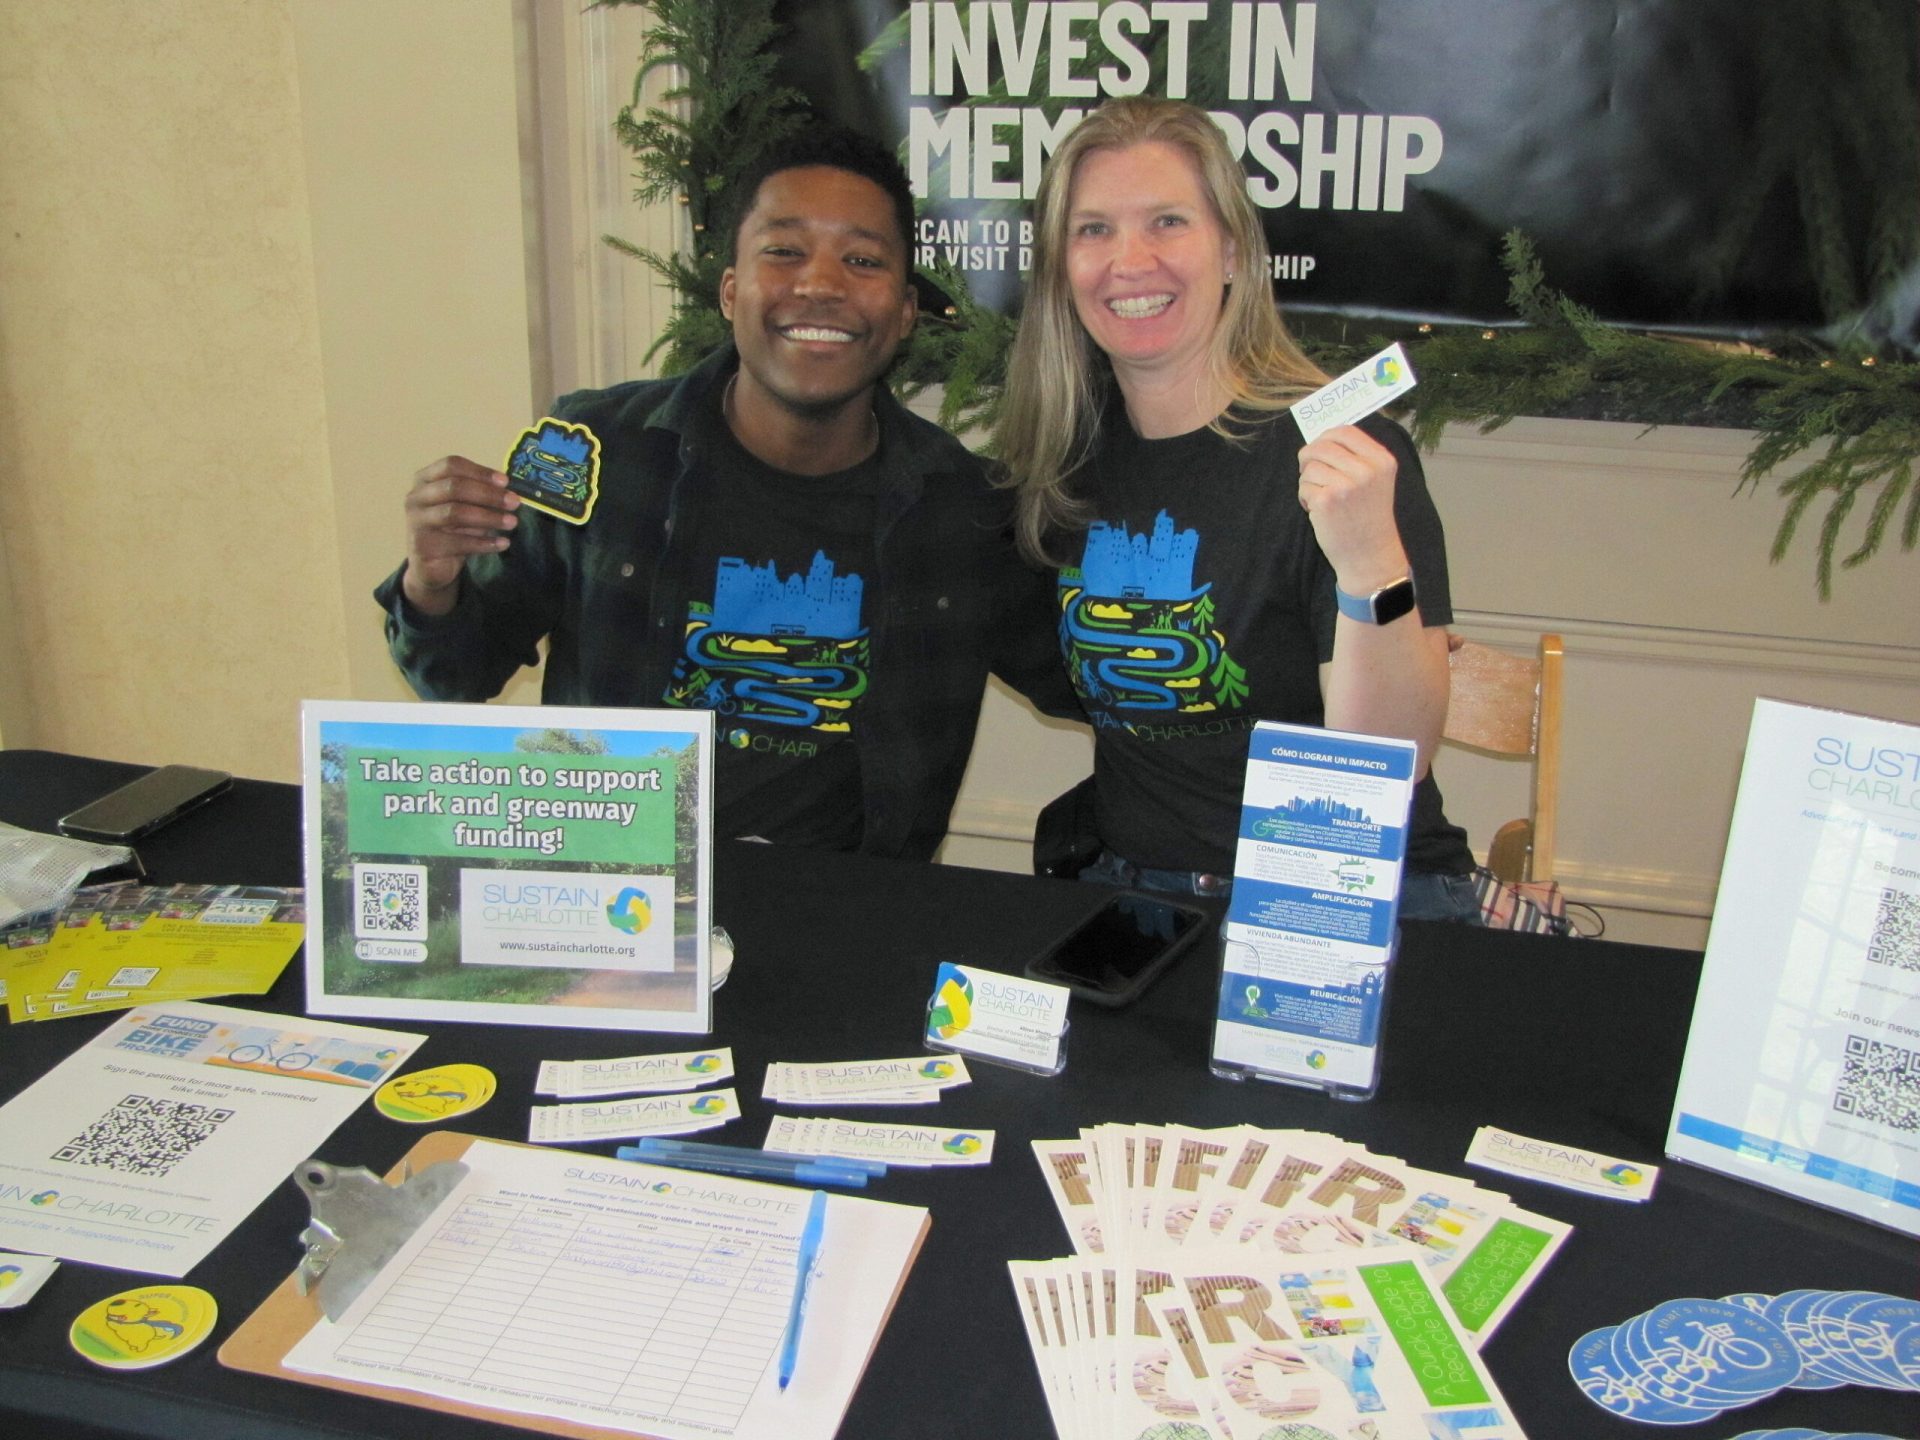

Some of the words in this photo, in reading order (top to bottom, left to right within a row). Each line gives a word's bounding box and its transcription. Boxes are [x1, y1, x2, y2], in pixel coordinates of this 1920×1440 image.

[910, 1, 1207, 99] INVEST
[1229, 2, 1316, 101] IN
[910, 107, 1443, 212] MEMSHIP
[979, 220, 1010, 245] TO
[945, 246, 1009, 271] VISIT
[1299, 372, 1369, 420] SUSTAIN
[1271, 747, 1297, 759] CÓMO
[1300, 752, 1333, 763] LOGRAR
[1335, 756, 1347, 765] UN
[1349, 758, 1388, 771] IMPACTO
[359, 758, 422, 782] Take
[429, 759, 511, 785] action
[518, 765, 547, 787] to
[554, 768, 661, 795] support
[384, 790, 446, 818] park
[450, 792, 499, 816] and
[507, 796, 636, 826] greenway
[1332, 818, 1382, 832] TRANSPORTE
[454, 822, 564, 854] funding!
[1256, 845, 1318, 860] COMUNICACIÓN
[483, 884, 599, 906] SUSTAIN
[1312, 892, 1373, 908] AMPLIFICACIÓN
[482, 906, 598, 926] CHARLOTTE
[500, 941, 635, 957] www.sustaincharlotte.org
[1247, 928, 1282, 941] VIVIENDA
[1284, 935, 1331, 949] ABUNDANTE
[376, 946, 405, 956] SCAN
[407, 947, 418, 958] ME
[980, 982, 1055, 1008] SUSTAIN
[1310, 989, 1362, 1005] REUBICACIÓN
[978, 996, 1052, 1021] CHARLOTTE
[1834, 1008, 1860, 1021] Join
[1864, 1017, 1886, 1028] our
[153, 1017, 208, 1030] FUND
[115, 1042, 187, 1057] PROJECTS
[123, 1029, 203, 1051] BIKE
[582, 1058, 678, 1073] SUSTAIN
[816, 1063, 912, 1078] SUSTAIN
[103, 1064, 127, 1073] Sign
[146, 1071, 186, 1083] petition
[188, 1077, 204, 1085] for
[205, 1080, 232, 1089] more
[261, 1089, 317, 1103] connected
[171, 1085, 193, 1093] bike
[196, 1089, 228, 1098] lanes!
[582, 1100, 681, 1117] SUSTAIN
[835, 1124, 937, 1141] SUSTAIN
[1491, 1133, 1596, 1167] SUSTAIN
[564, 1168, 649, 1189] SUSTAIN
[673, 1186, 800, 1214] CHARLOTTE
[57, 1195, 220, 1233] CHARLOTTE
[499, 1189, 518, 1198] Want
[549, 1196, 571, 1205] about
[573, 1200, 604, 1211] exciting
[606, 1207, 658, 1220] sustainability
[660, 1214, 692, 1225] updates
[695, 1220, 711, 1228] and
[712, 1223, 733, 1232] ways
[1474, 1239, 1507, 1270] Guide
[1501, 1223, 1522, 1241] to
[1373, 1269, 1390, 1285] to
[1462, 1267, 1513, 1315] Recycle
[1501, 1239, 1536, 1271] Right
[1384, 1288, 1417, 1331] Guide
[1400, 1279, 1431, 1316] Right
[1657, 1306, 1693, 1330] that's
[1698, 1305, 1736, 1318] how
[1744, 1317, 1767, 1333] we
[1407, 1332, 1444, 1380] Quick
[1423, 1318, 1471, 1384] Recycle
[1433, 1385, 1456, 1400] A
